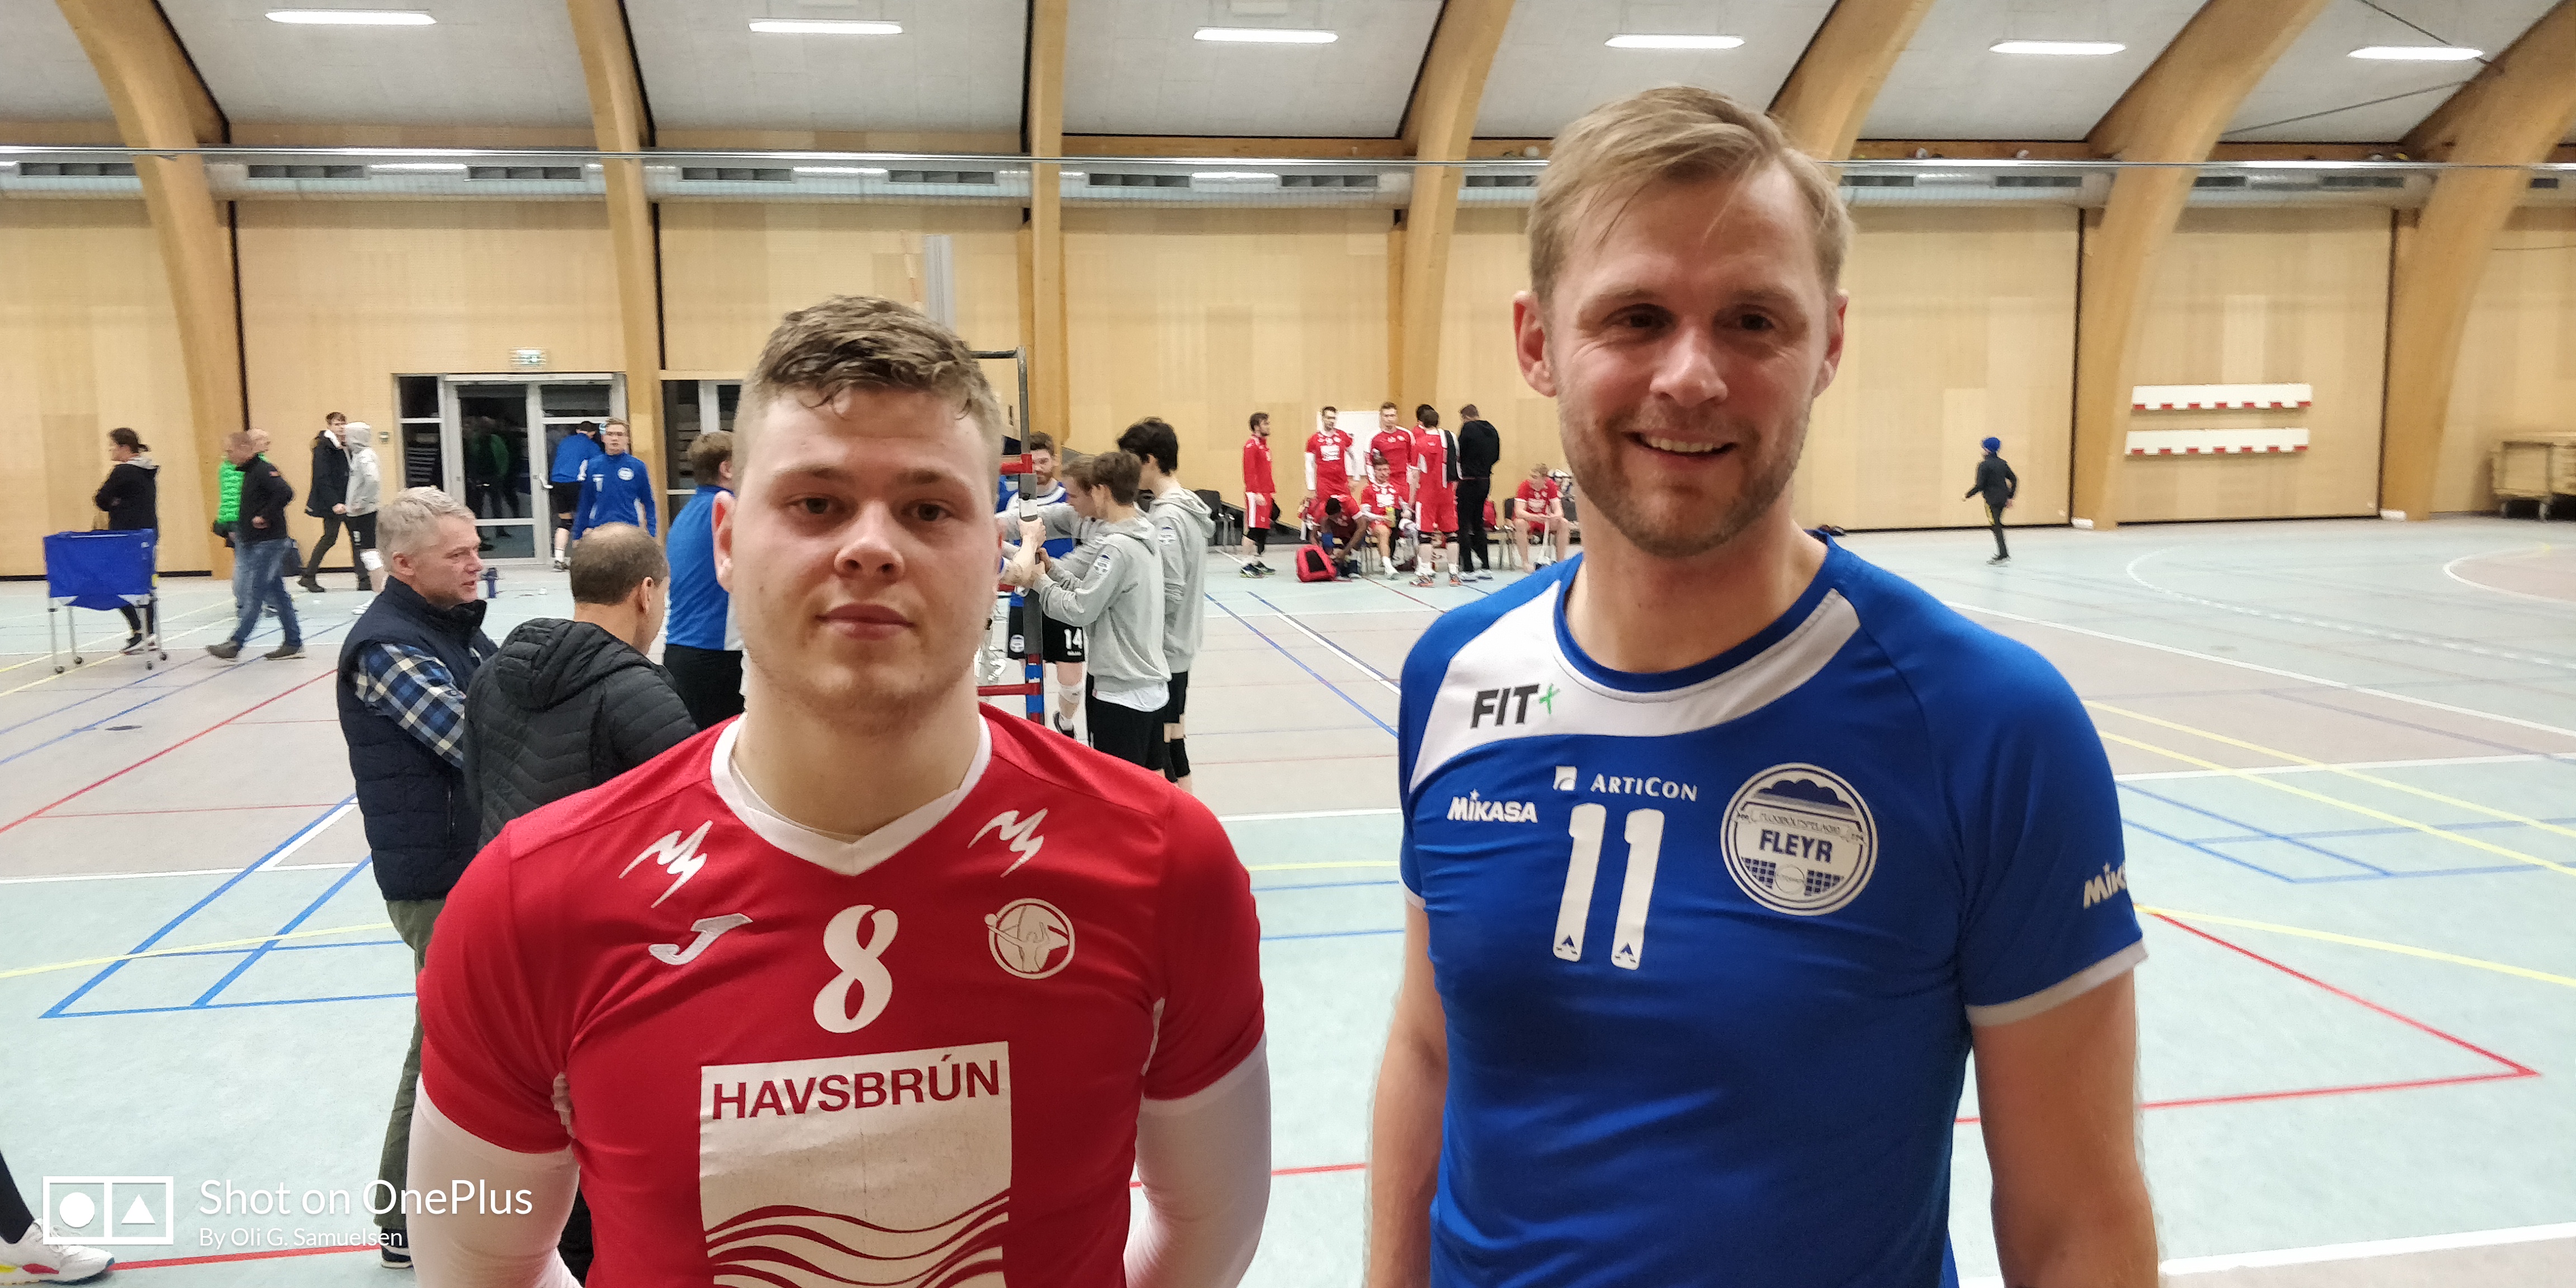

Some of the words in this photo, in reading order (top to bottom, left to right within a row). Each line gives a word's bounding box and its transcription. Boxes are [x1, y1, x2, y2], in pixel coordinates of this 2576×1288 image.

[1064, 628, 1083, 650] 14
[1759, 828, 1833, 864] FLEYR
[1552, 802, 1665, 970] 11
[813, 904, 898, 1034] 8
[712, 1054, 1000, 1120] HAVSBRÚN
